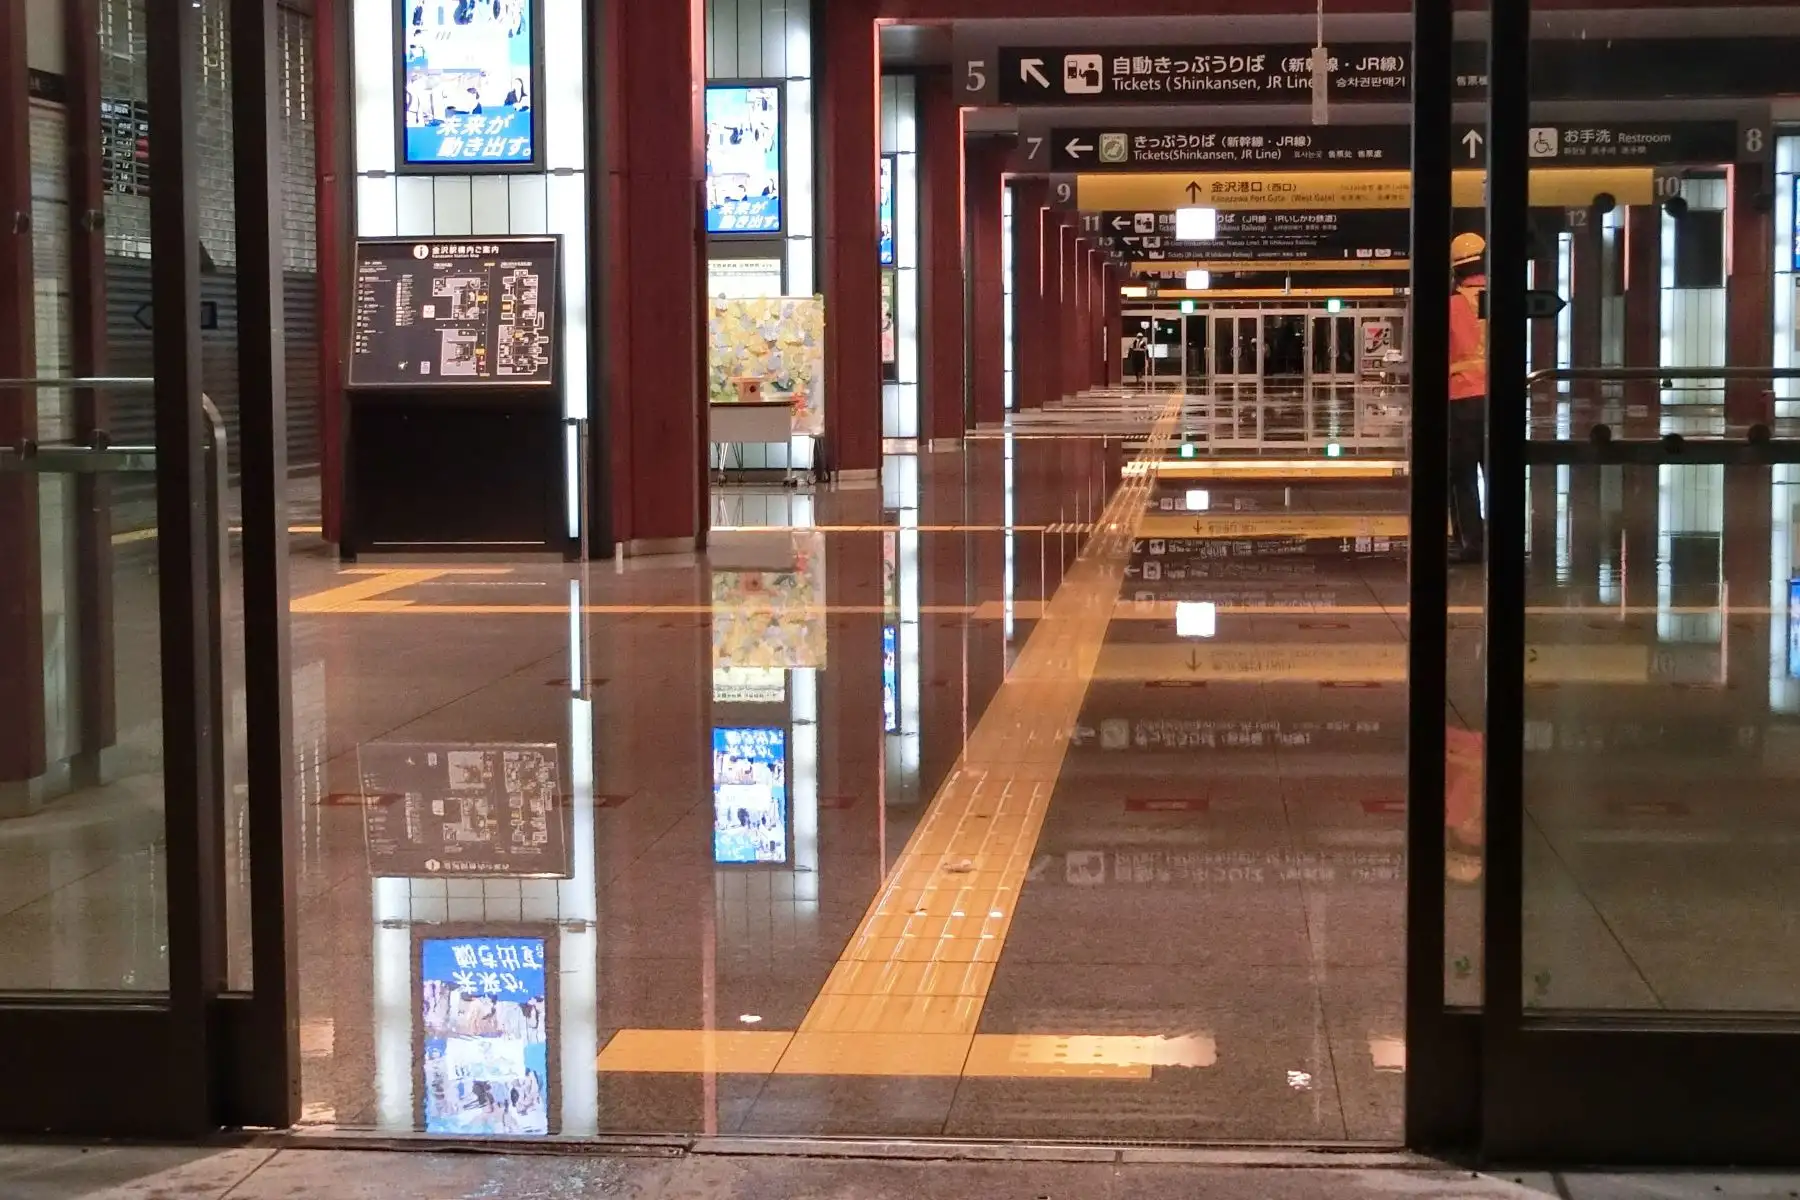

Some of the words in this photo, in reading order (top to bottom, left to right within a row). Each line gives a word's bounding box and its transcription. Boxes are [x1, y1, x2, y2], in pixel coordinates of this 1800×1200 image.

[1112, 54, 1265, 75] 自動きっぷうりば
[965, 60, 986, 91] 5
[1112, 76, 1161, 92] Tickets
[1166, 76, 1261, 93] (Shinkansen,
[1265, 76, 1283, 91] JR
[1335, 76, 1407, 90] 승차권판매기
[437, 113, 515, 136] 未来が
[1133, 135, 1215, 149] きっぷうりば
[1563, 129, 1611, 144] お手洗
[1618, 131, 1672, 144] Restroom
[1745, 128, 1764, 153] 8
[437, 136, 531, 158] 動き出す。
[1026, 136, 1043, 160] 7
[1240, 149, 1254, 160] JR
[1255, 149, 1282, 162] Line)
[1057, 182, 1071, 203] 9
[1211, 181, 1263, 193] 金沢港口
[1654, 176, 1680, 198] 10
[1082, 215, 1100, 231] 11
[1566, 209, 1588, 228] 12
